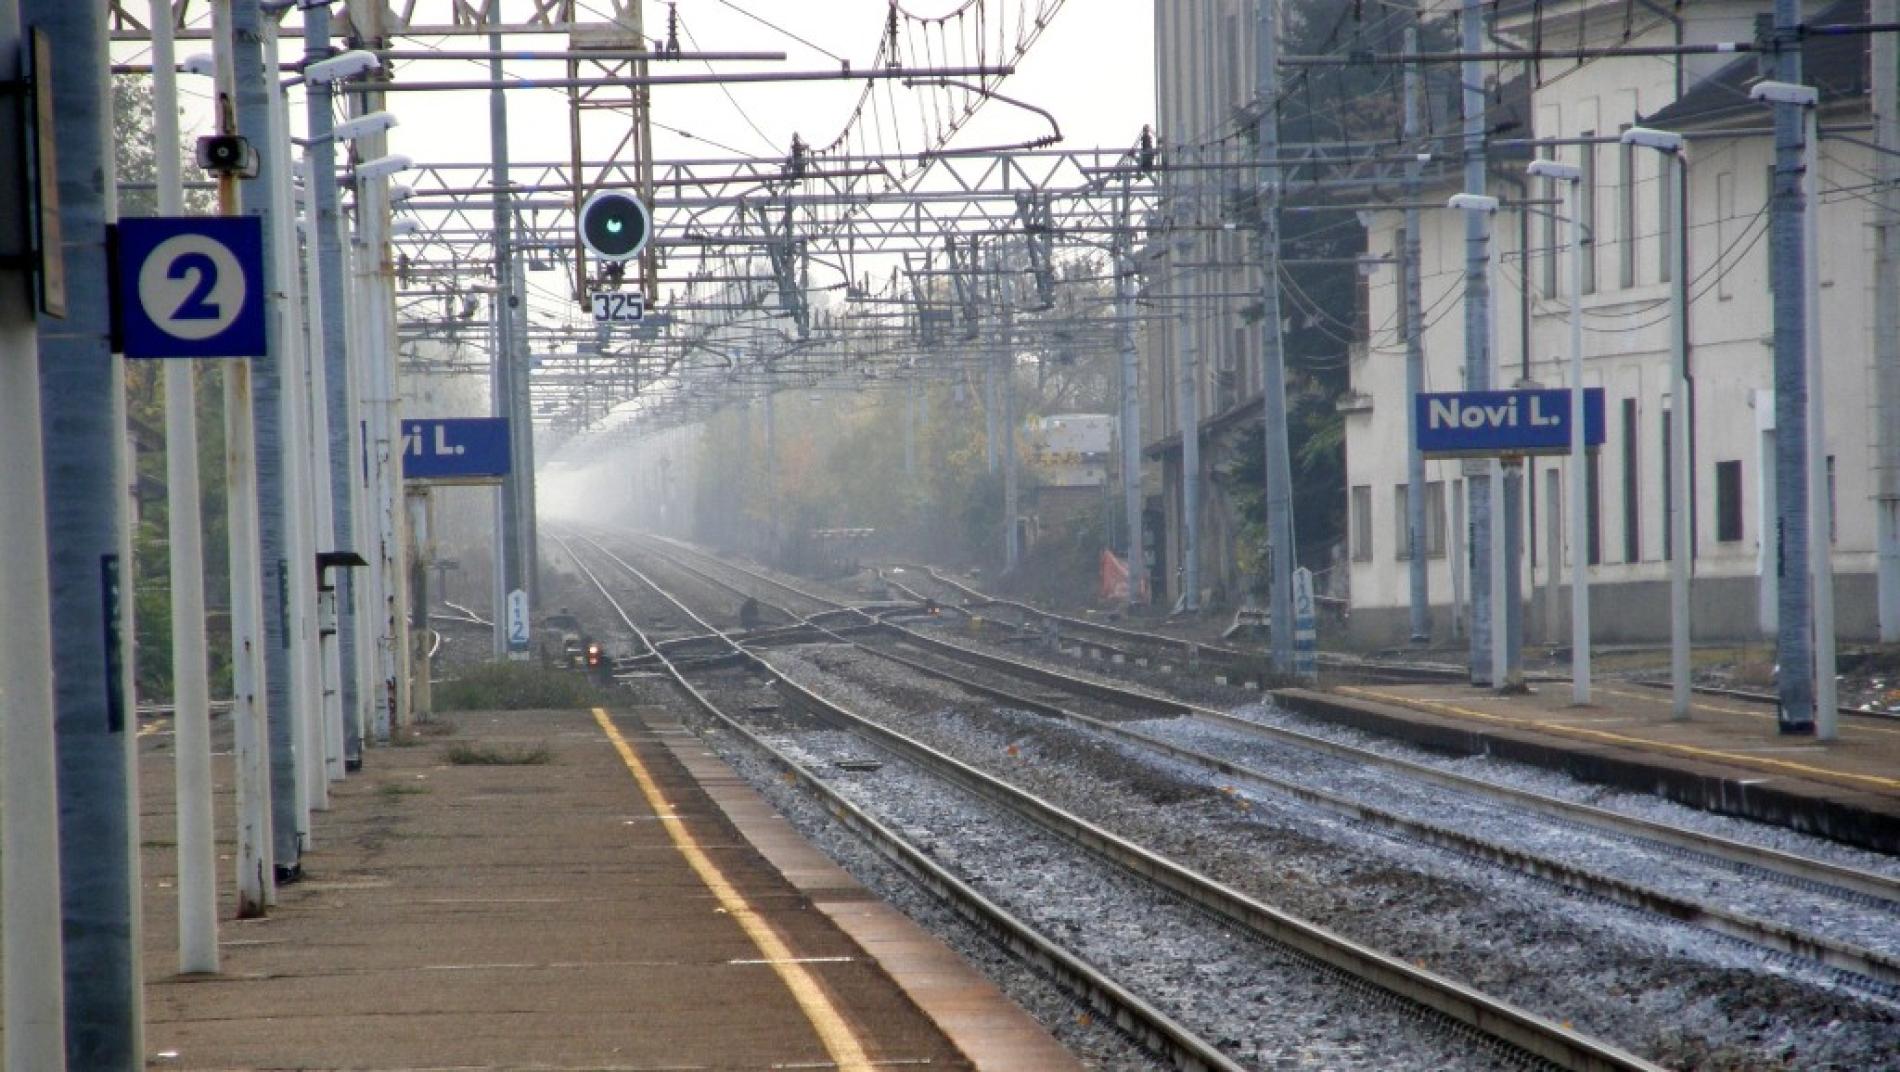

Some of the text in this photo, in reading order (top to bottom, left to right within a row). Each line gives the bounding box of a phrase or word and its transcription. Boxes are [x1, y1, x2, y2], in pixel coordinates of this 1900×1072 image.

[166, 252, 220, 320] 2
[595, 293, 643, 321] 325
[1429, 396, 1561, 430] Novi L.
[435, 424, 465, 456] L.
